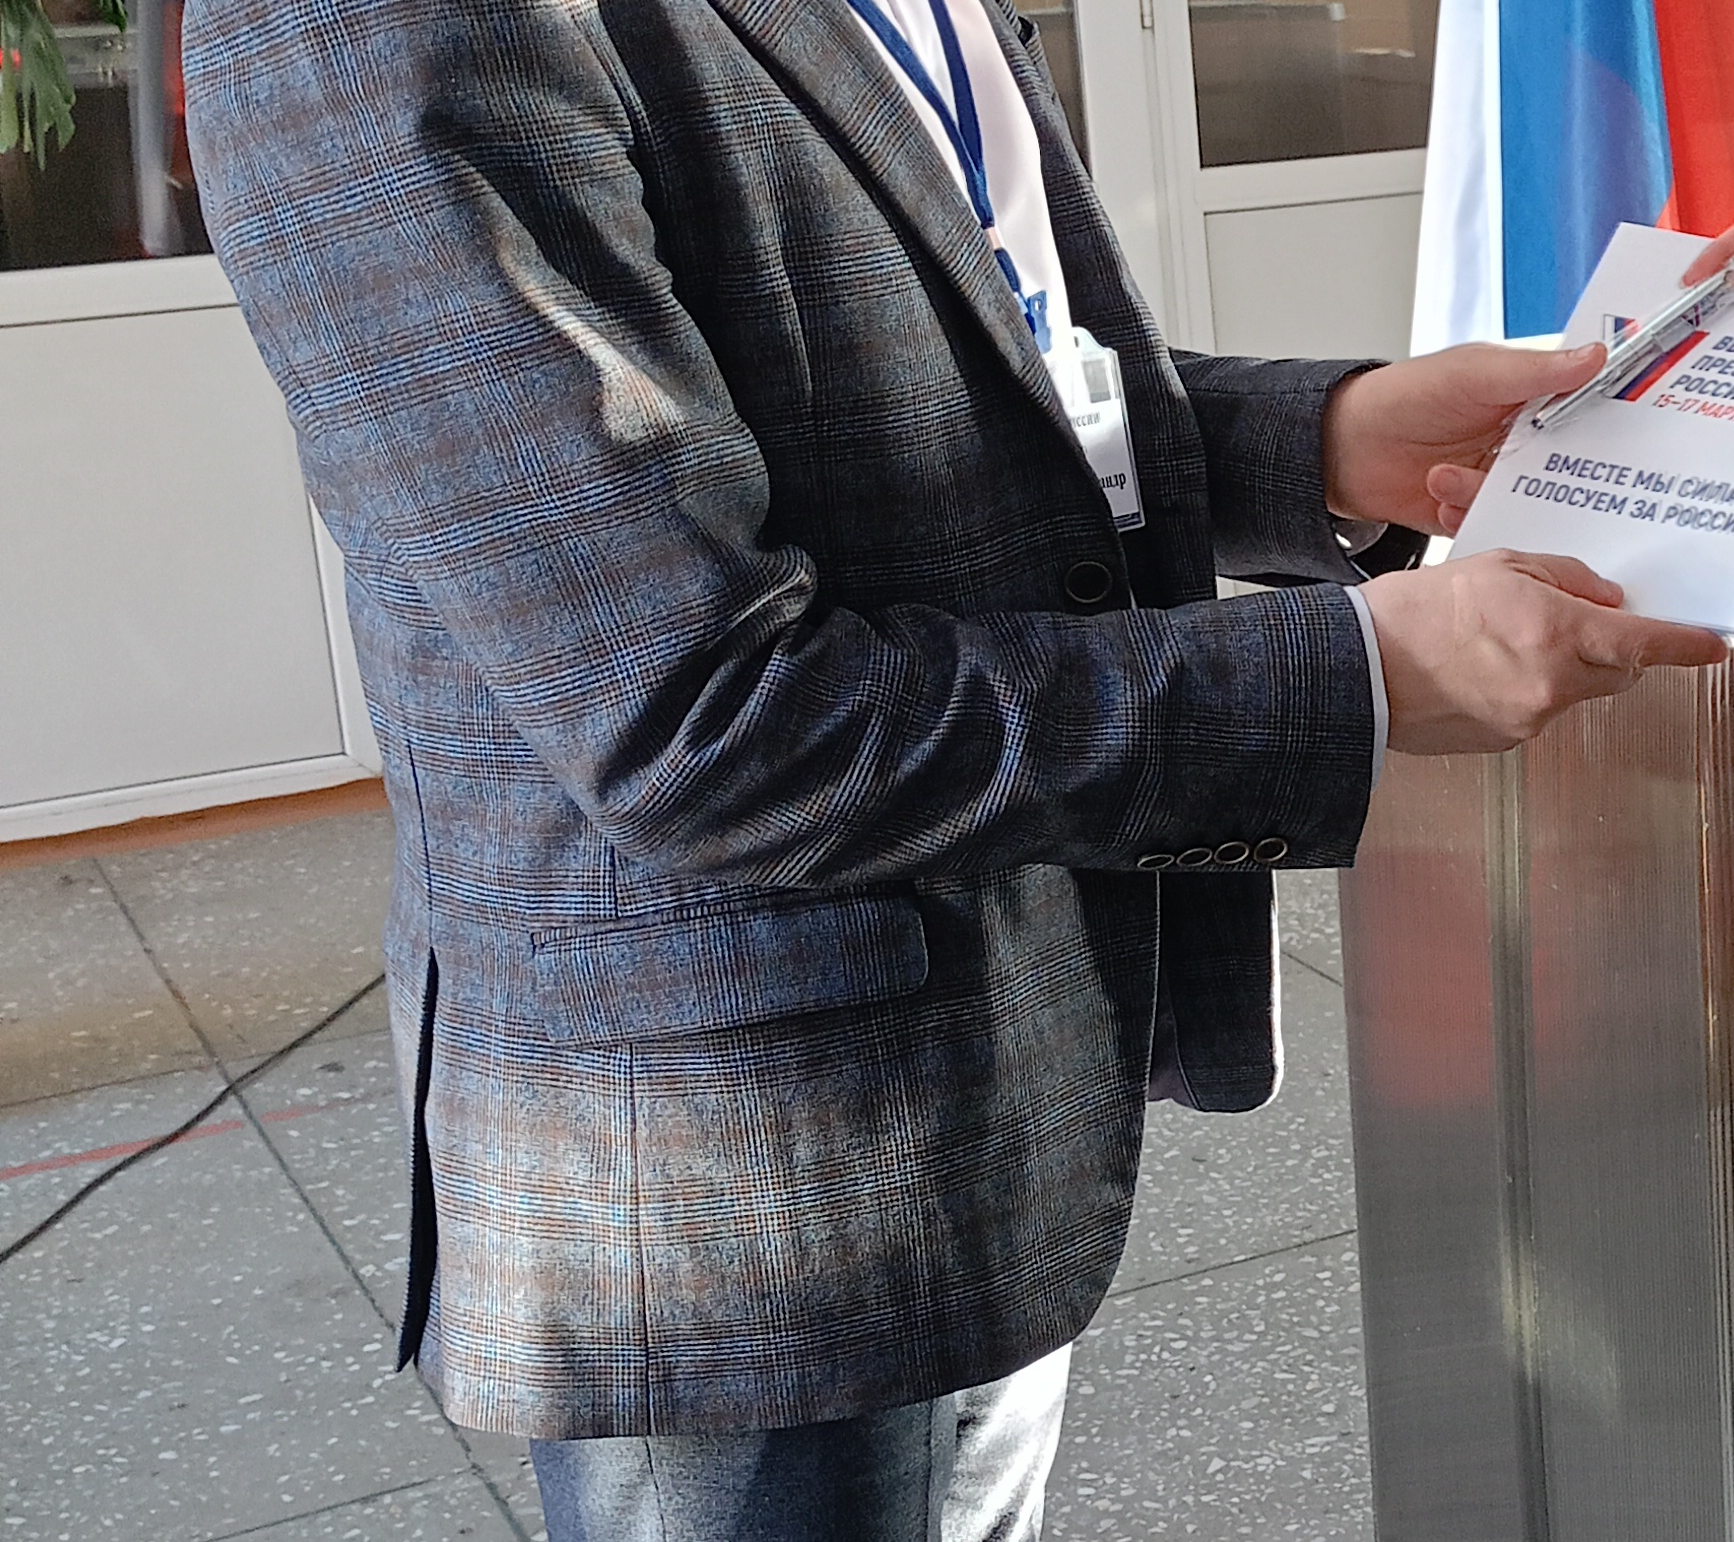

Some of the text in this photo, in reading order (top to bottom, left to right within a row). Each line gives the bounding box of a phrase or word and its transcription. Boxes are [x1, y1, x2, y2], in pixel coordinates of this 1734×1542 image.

[1543, 452, 1632, 487] ВМЕСТЕ
[1633, 470, 1672, 494] МЫ
[1511, 475, 1629, 516] ГОЛОСУЕМ
[1630, 499, 1657, 524] ЗА
